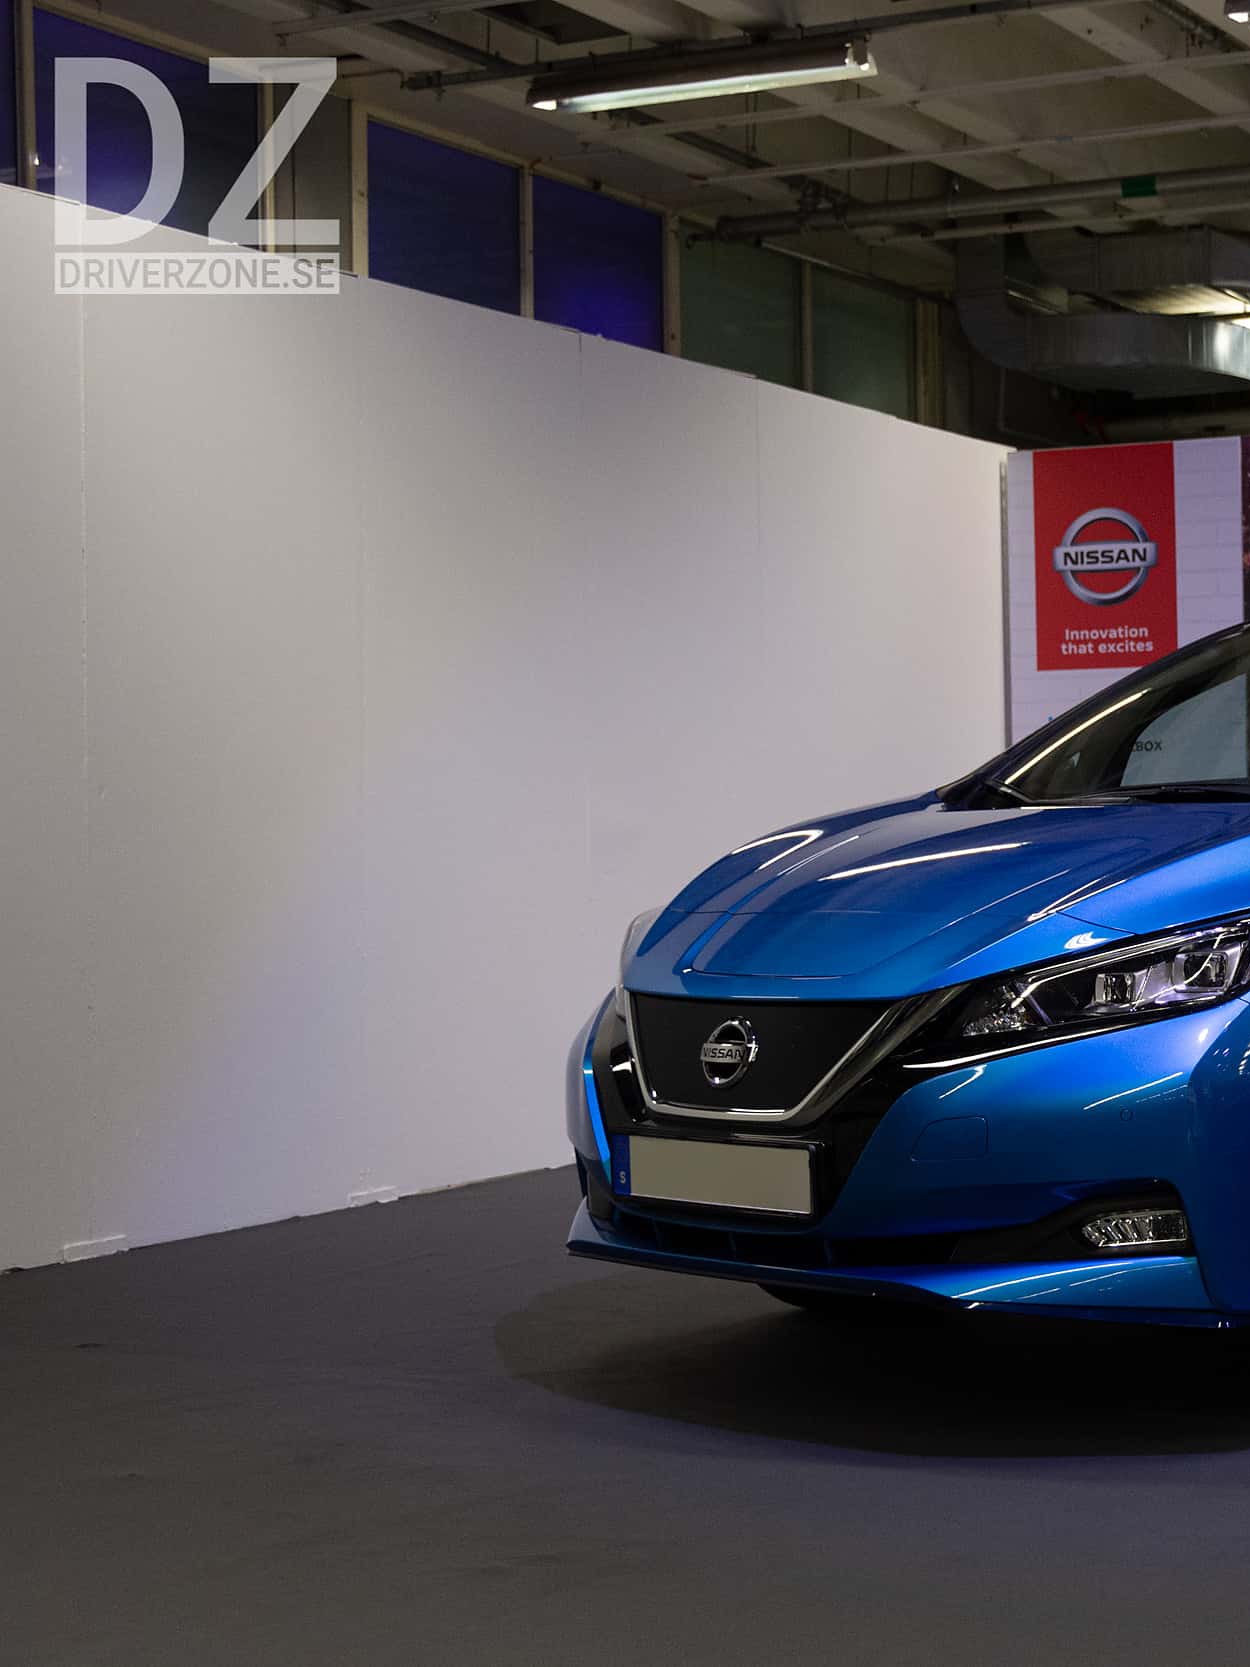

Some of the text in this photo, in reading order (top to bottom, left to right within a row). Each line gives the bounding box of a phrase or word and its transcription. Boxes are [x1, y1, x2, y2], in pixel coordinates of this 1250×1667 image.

[1063, 548, 1147, 566] NISSAN
[1064, 625, 1148, 640] Innovation
[1060, 640, 1153, 655] that excites
[1135, 740, 1162, 751] BOX
[703, 1047, 745, 1060] NISSAN
[619, 1171, 626, 1184] S
